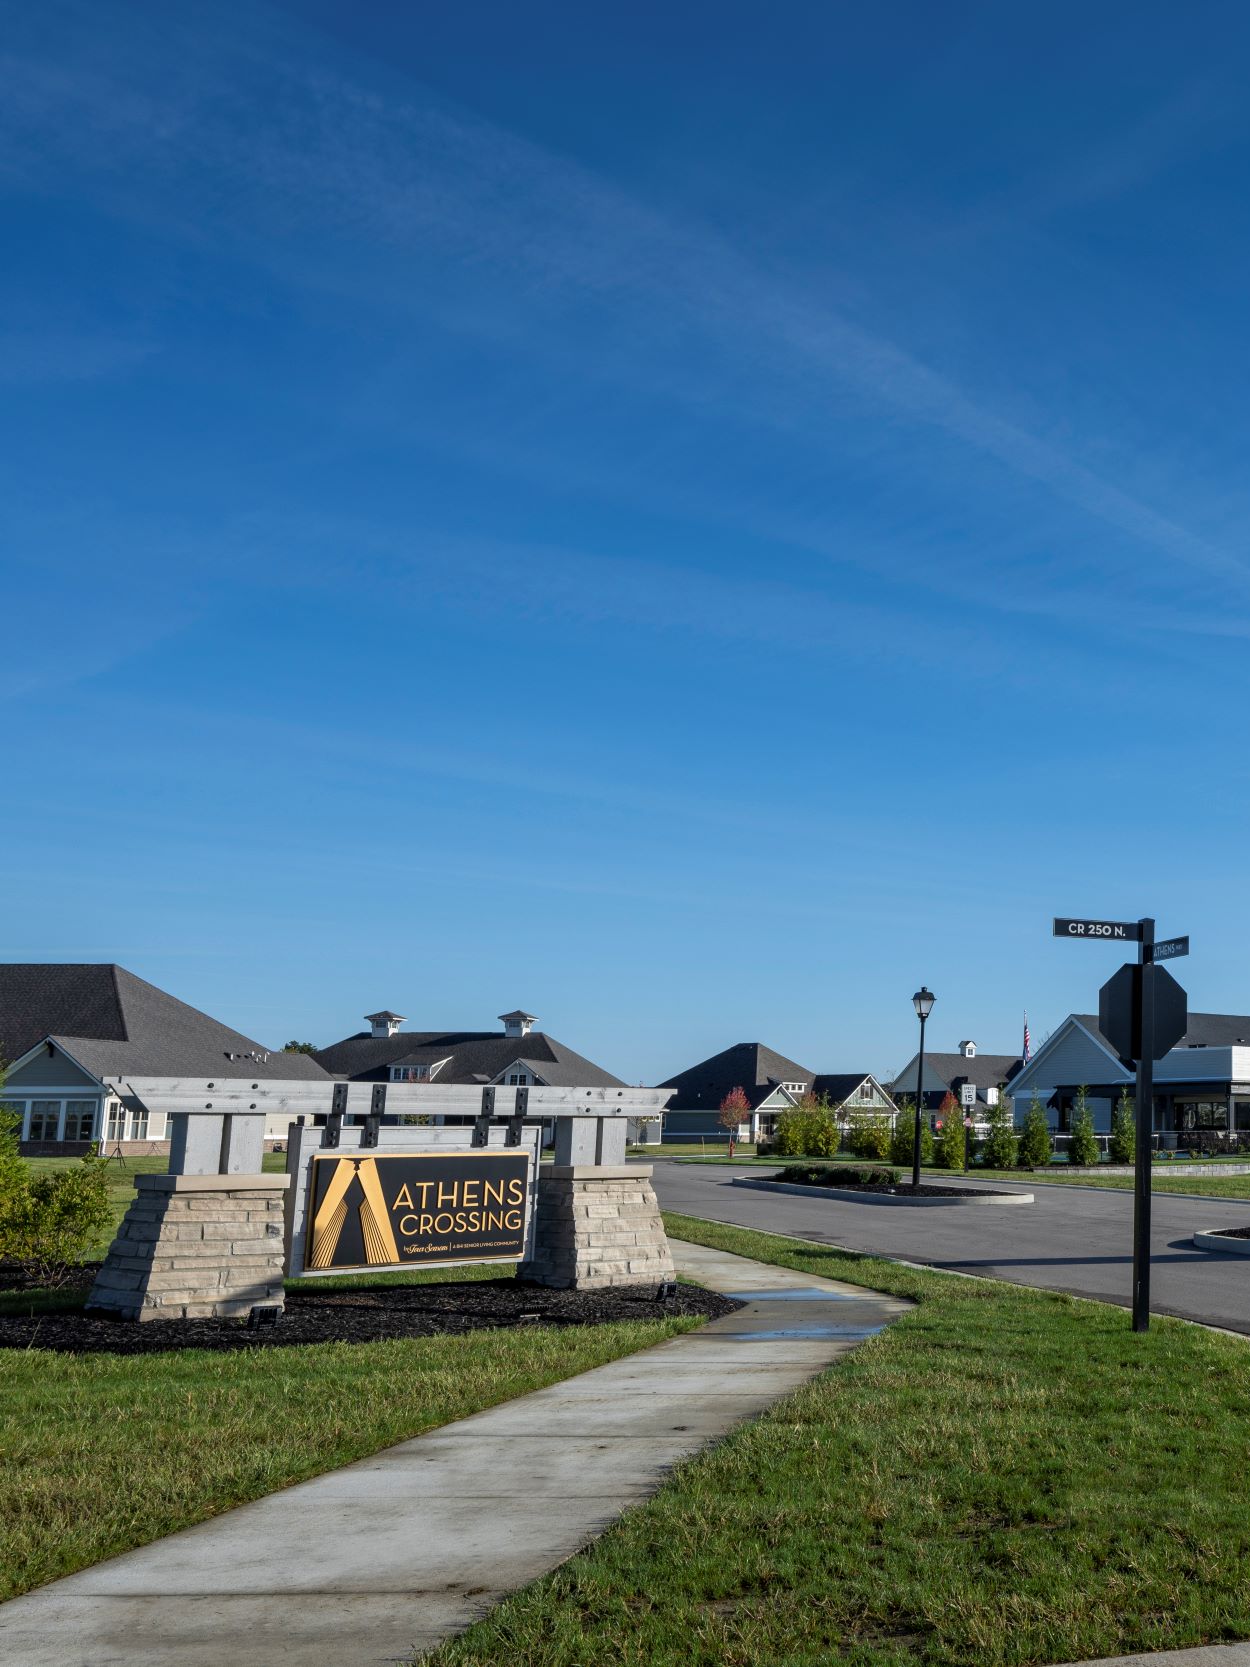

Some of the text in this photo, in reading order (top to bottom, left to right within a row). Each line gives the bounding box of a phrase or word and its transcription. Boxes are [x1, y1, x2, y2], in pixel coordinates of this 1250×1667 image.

[1068, 923, 1126, 937] CR 250 N.
[1153, 943, 1175, 957] ATHENS
[965, 1094, 973, 1102] 15
[392, 1179, 523, 1211] ATHENS
[400, 1210, 522, 1235] CROSSING
